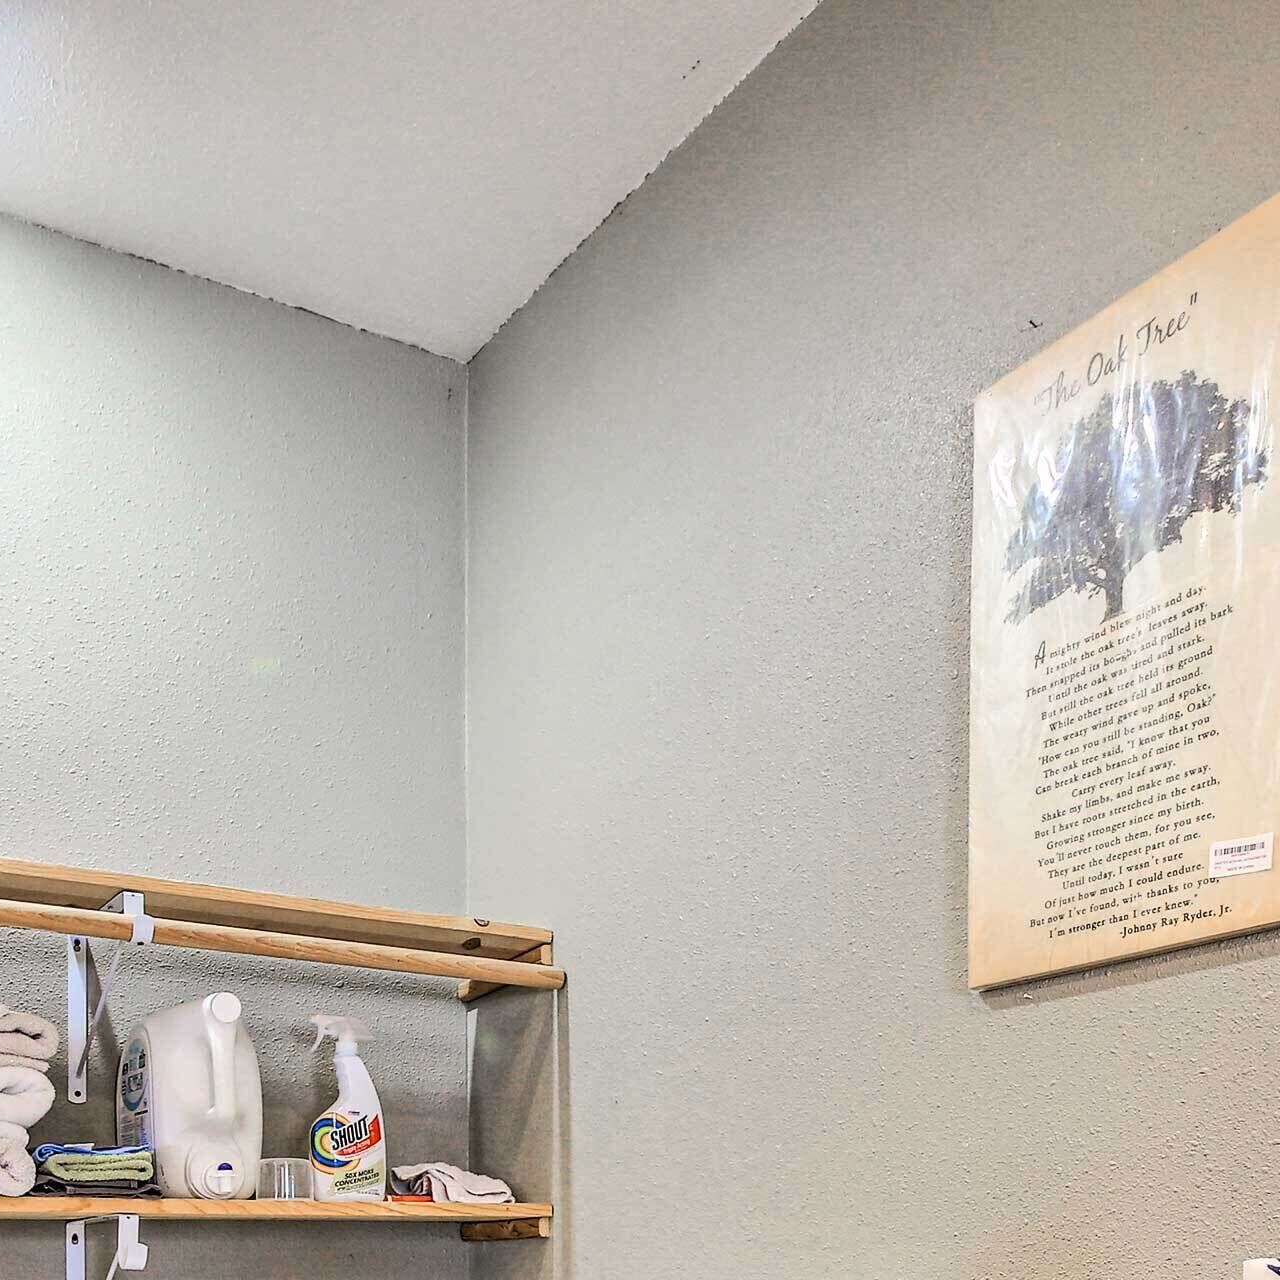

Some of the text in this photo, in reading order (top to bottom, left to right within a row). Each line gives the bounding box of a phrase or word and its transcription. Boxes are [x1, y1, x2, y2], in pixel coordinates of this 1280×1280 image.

[1087, 334, 1128, 386] Oak
[1136, 291, 1198, 356] Tree"
[1025, 603, 1233, 698] Then snapped its pulled its bark
[1034, 639, 1046, 670] A
[1083, 626, 1106, 644] wind
[1164, 592, 1183, 608] and
[1046, 639, 1115, 676] It the oak
[1090, 633, 1205, 686] oak stark.
[1096, 644, 1213, 699] oak ground
[1042, 737, 1060, 749] The
[1062, 727, 1089, 743] weary
[1090, 715, 1114, 731] wind
[1117, 709, 1139, 725] gave
[1141, 703, 1154, 714] up
[1157, 692, 1175, 708] and
[1048, 666, 1203, 732] While other trees around.
[1035, 784, 1052, 795] Can
[1054, 773, 1079, 789] break
[1081, 765, 1102, 780] each
[1105, 753, 1138, 772] branch
[1141, 747, 1154, 760] of
[1155, 741, 1180, 755] mine
[1183, 736, 1194, 746] in
[1042, 768, 1060, 779] The
[1062, 759, 1078, 772] oak
[1081, 755, 1099, 766] tree
[1168, 723, 1188, 736] that
[1191, 716, 1210, 731] you
[1064, 746, 1080, 757] can
[1082, 739, 1099, 753] you
[1102, 728, 1120, 744] still
[1041, 808, 1066, 823] Shake
[1069, 804, 1082, 814] my
[1116, 785, 1133, 799] and
[1136, 779, 1162, 793] make
[1165, 773, 1180, 784] me
[1071, 775, 1124, 798] Carry every
[1033, 829, 1049, 840] But
[1052, 824, 1056, 834] I
[1058, 820, 1079, 832] have
[1082, 811, 1106, 825] roots
[1109, 794, 1154, 816] stretched
[1156, 792, 1167, 802] in
[1170, 786, 1187, 798] the
[1046, 797, 1204, 850] Growing stronger since my birth.
[1047, 832, 1201, 879] They are the deepest part of me.
[1067, 846, 1092, 859] never
[1094, 835, 1121, 851] touch
[1154, 823, 1170, 834] for
[1173, 817, 1192, 832] you
[1044, 863, 1205, 909] Of just how much I could endure.
[1062, 875, 1085, 890] Until
[1118, 865, 1123, 875] I
[1125, 855, 1159, 872] wasn't
[1162, 852, 1184, 863] sure
[1029, 918, 1045, 928] But
[1047, 913, 1065, 924] now
[1068, 906, 1087, 918] I've
[1089, 897, 1119, 913] found,
[1146, 883, 1179, 899] thanks
[1182, 881, 1193, 890] to
[1049, 926, 1066, 939] I'm
[1068, 919, 1106, 934] stronger
[1108, 913, 1129, 924] than
[1132, 909, 1137, 919] I
[1140, 906, 1162, 917] ever
[1160, 917, 1179, 927] Ray
[1182, 909, 1216, 923] Ryder,
[1218, 904, 1232, 918] Jr.
[330, 1115, 368, 1150] SHOUT
[334, 1172, 380, 1188] CONCENTRATED
[358, 1168, 374, 1178] MORE
